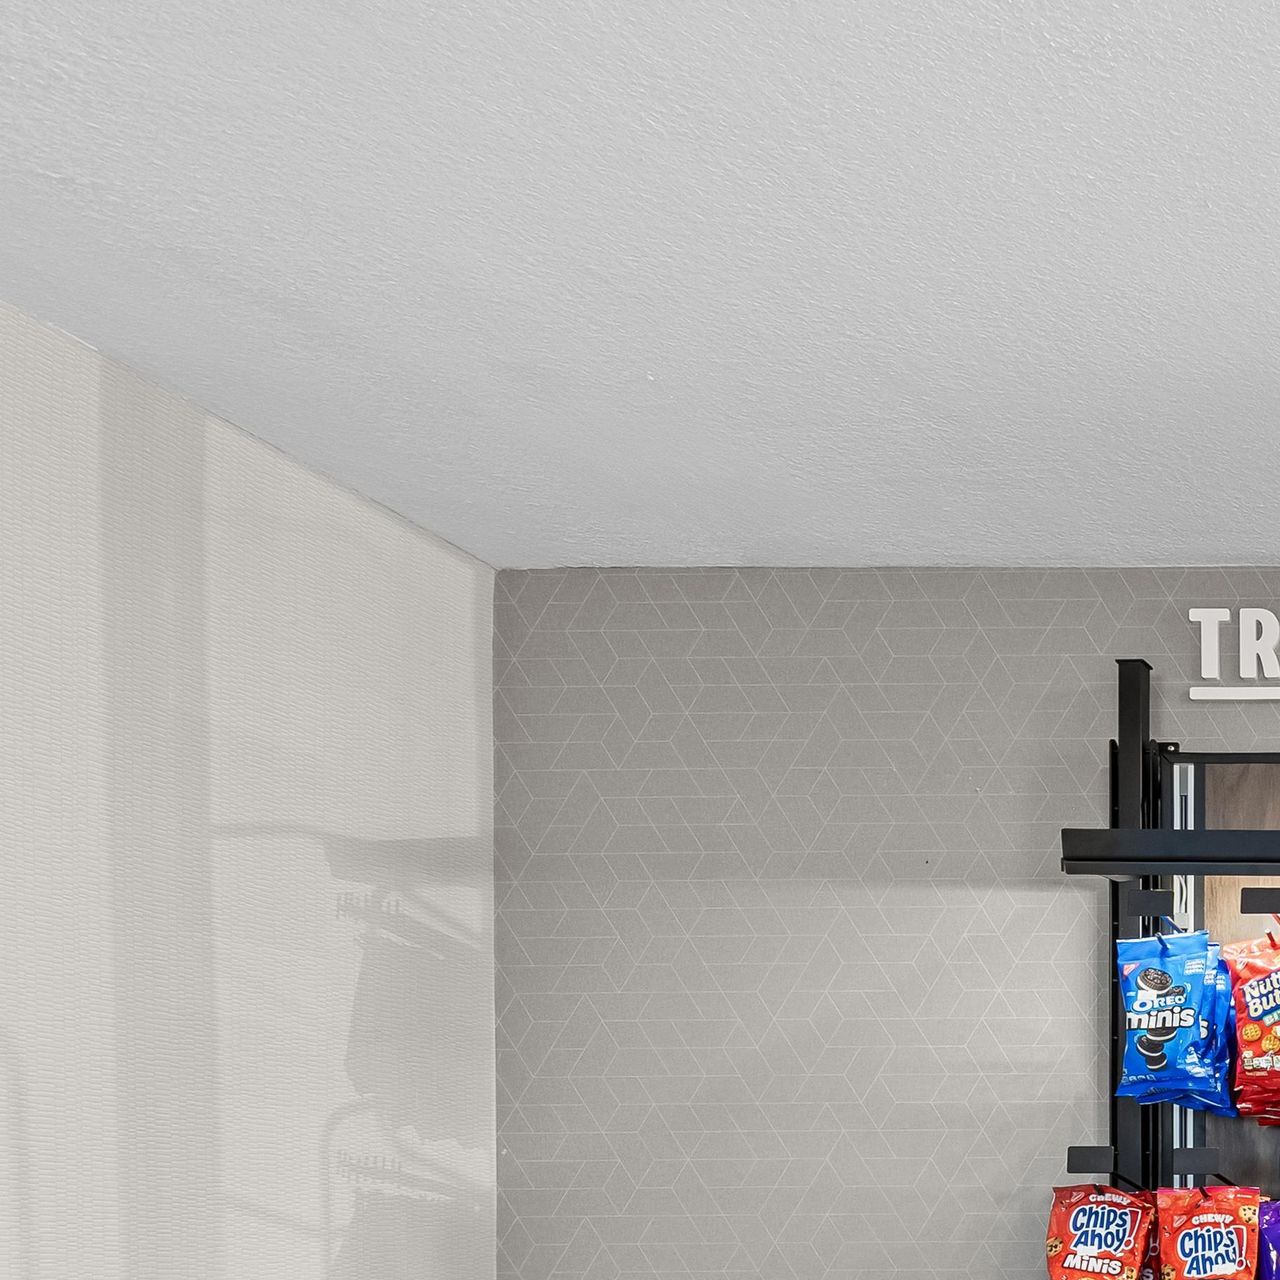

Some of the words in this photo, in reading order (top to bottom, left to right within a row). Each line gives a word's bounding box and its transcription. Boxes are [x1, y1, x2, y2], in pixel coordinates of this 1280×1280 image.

[1132, 995, 1186, 1012] OREO
[1126, 1007, 1195, 1030] minis
[1072, 1206, 1129, 1230] Chips
[1179, 1229, 1236, 1258] Chips
